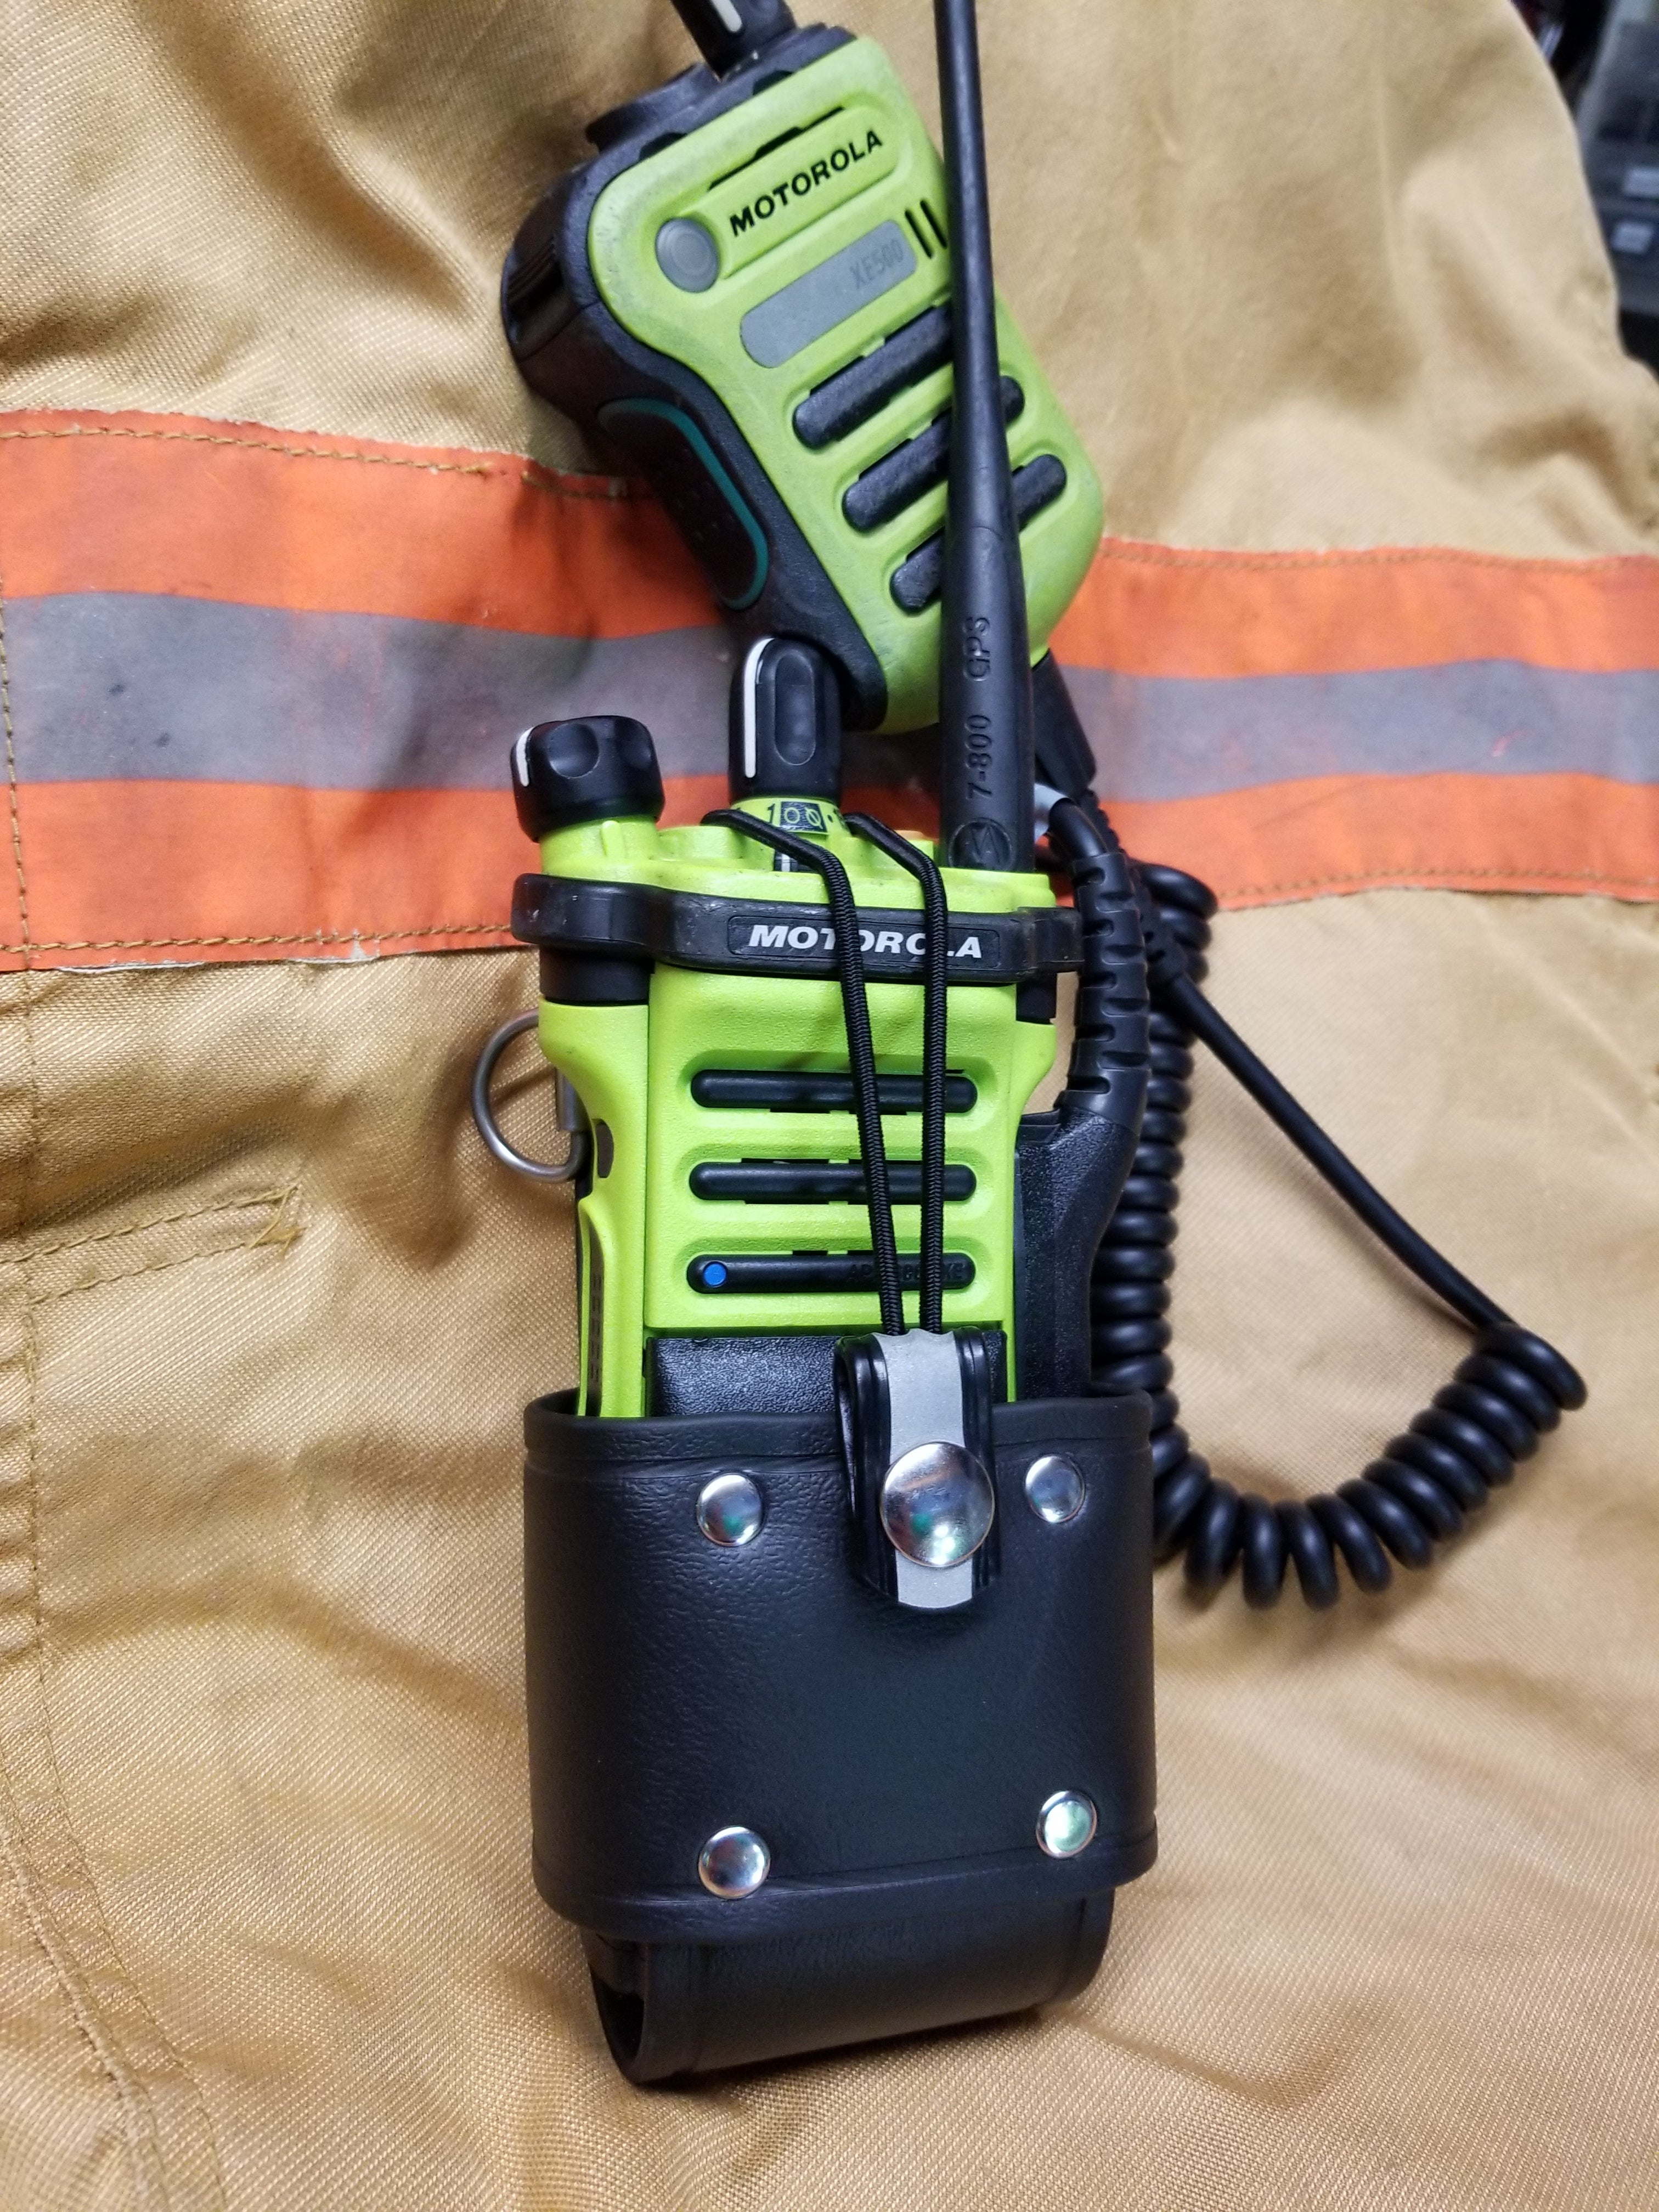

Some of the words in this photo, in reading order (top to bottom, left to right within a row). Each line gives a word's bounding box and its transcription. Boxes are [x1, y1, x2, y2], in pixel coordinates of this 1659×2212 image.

[729, 129, 883, 237] MOTOROLA
[850, 239, 904, 289] XE500
[963, 617, 991, 682] GPS
[964, 714, 992, 799] 7-800
[748, 924, 981, 958] MOTOROA
